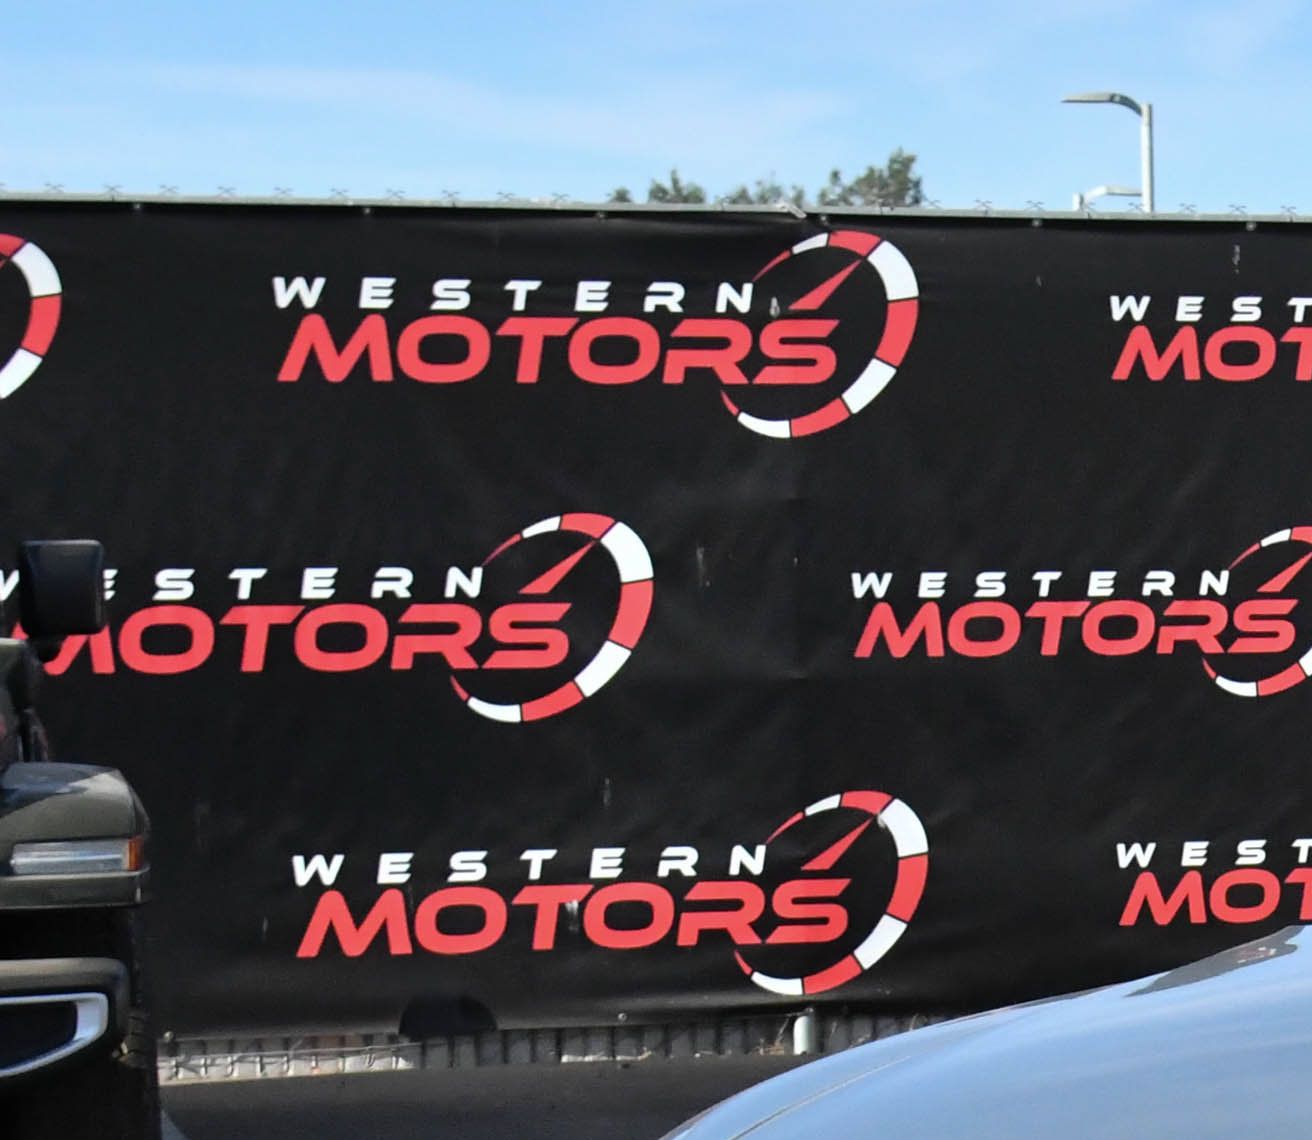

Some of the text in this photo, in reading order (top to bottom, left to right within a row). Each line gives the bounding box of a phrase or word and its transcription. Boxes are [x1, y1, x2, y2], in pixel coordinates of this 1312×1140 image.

[274, 277, 753, 313] WESTERN
[278, 314, 838, 384] MOTORS
[852, 570, 1229, 598] WESTERN
[855, 599, 1298, 657] MOTORS
[293, 844, 766, 886] WESTERN
[297, 879, 855, 958] MOTORS
